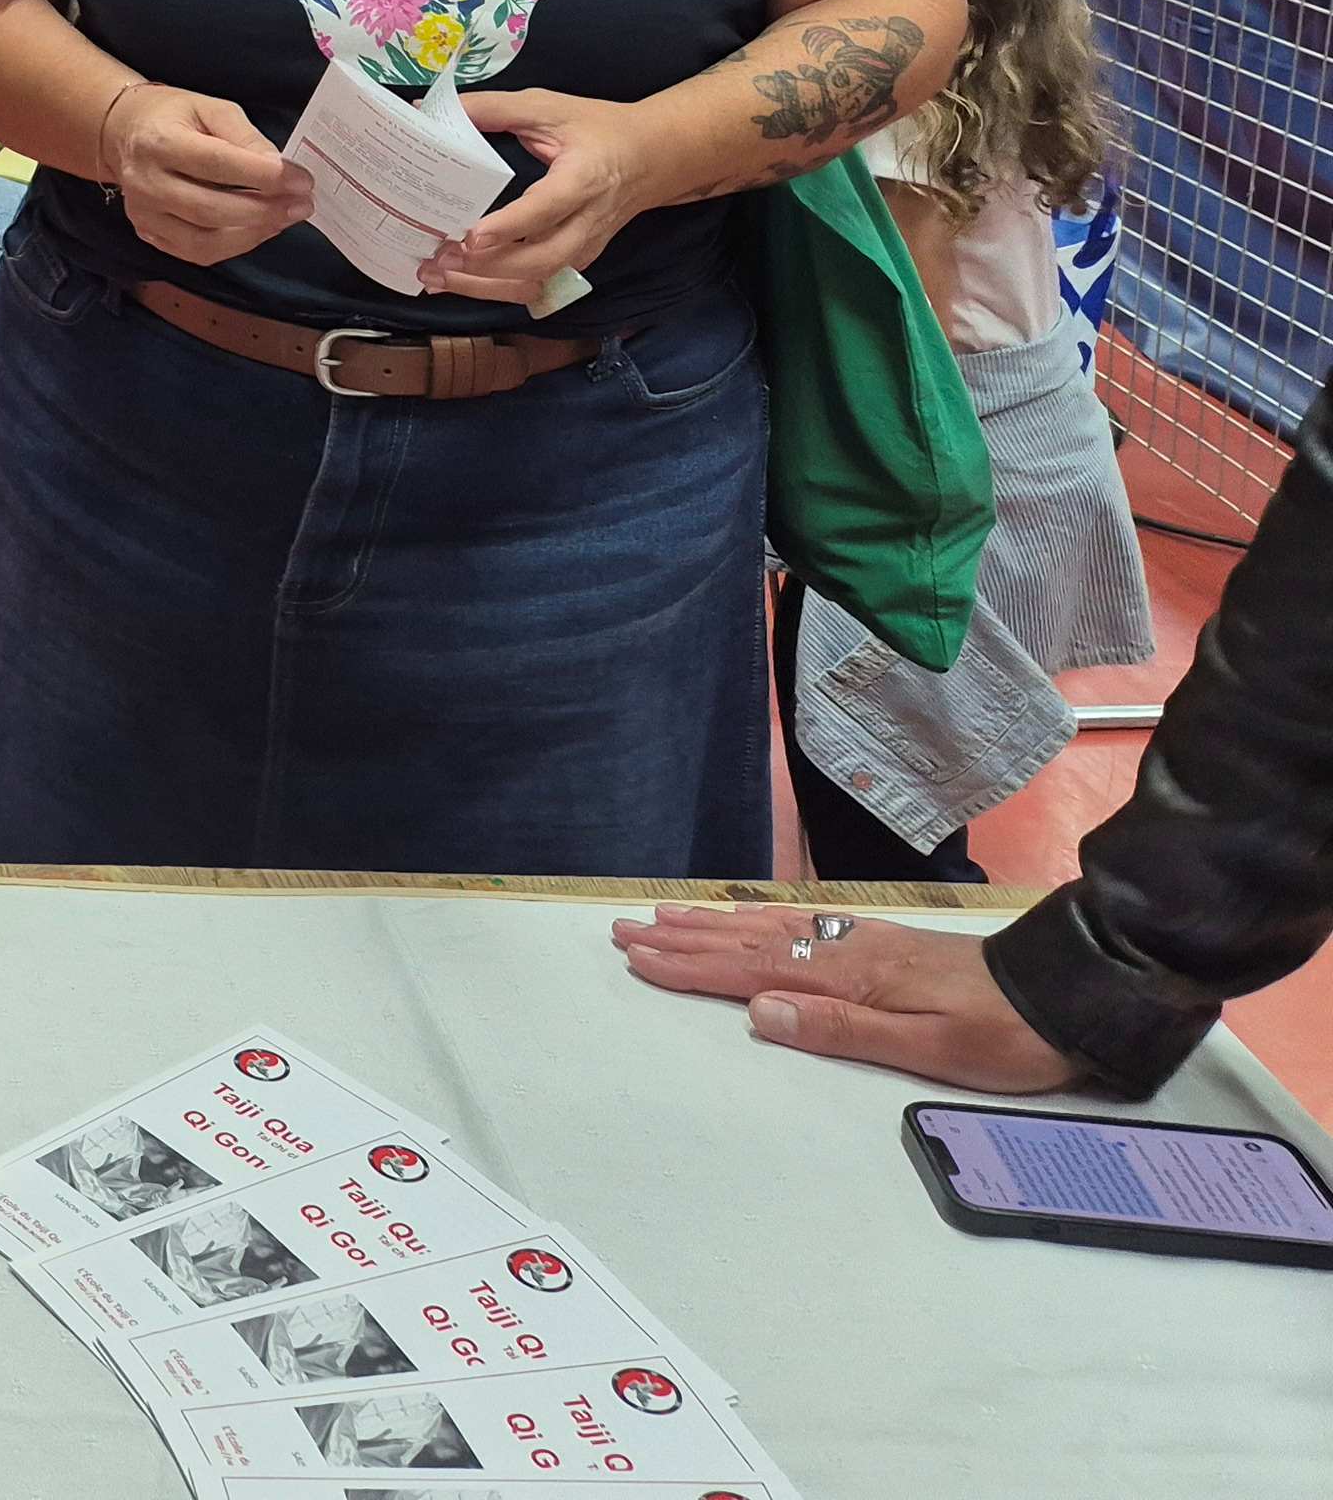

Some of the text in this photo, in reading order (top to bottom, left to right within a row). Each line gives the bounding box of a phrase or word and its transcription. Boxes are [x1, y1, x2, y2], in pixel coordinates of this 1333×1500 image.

[183, 1110, 272, 1170] Qi Gon
[213, 1082, 315, 1154] Taiji Qua
[300, 1204, 335, 1228] Qi
[339, 1177, 432, 1255] Taiji Qu
[422, 1305, 458, 1332] Qi
[469, 1279, 523, 1330] Taiji
[507, 1413, 544, 1441] Qi
[563, 1393, 617, 1446] Taiji
